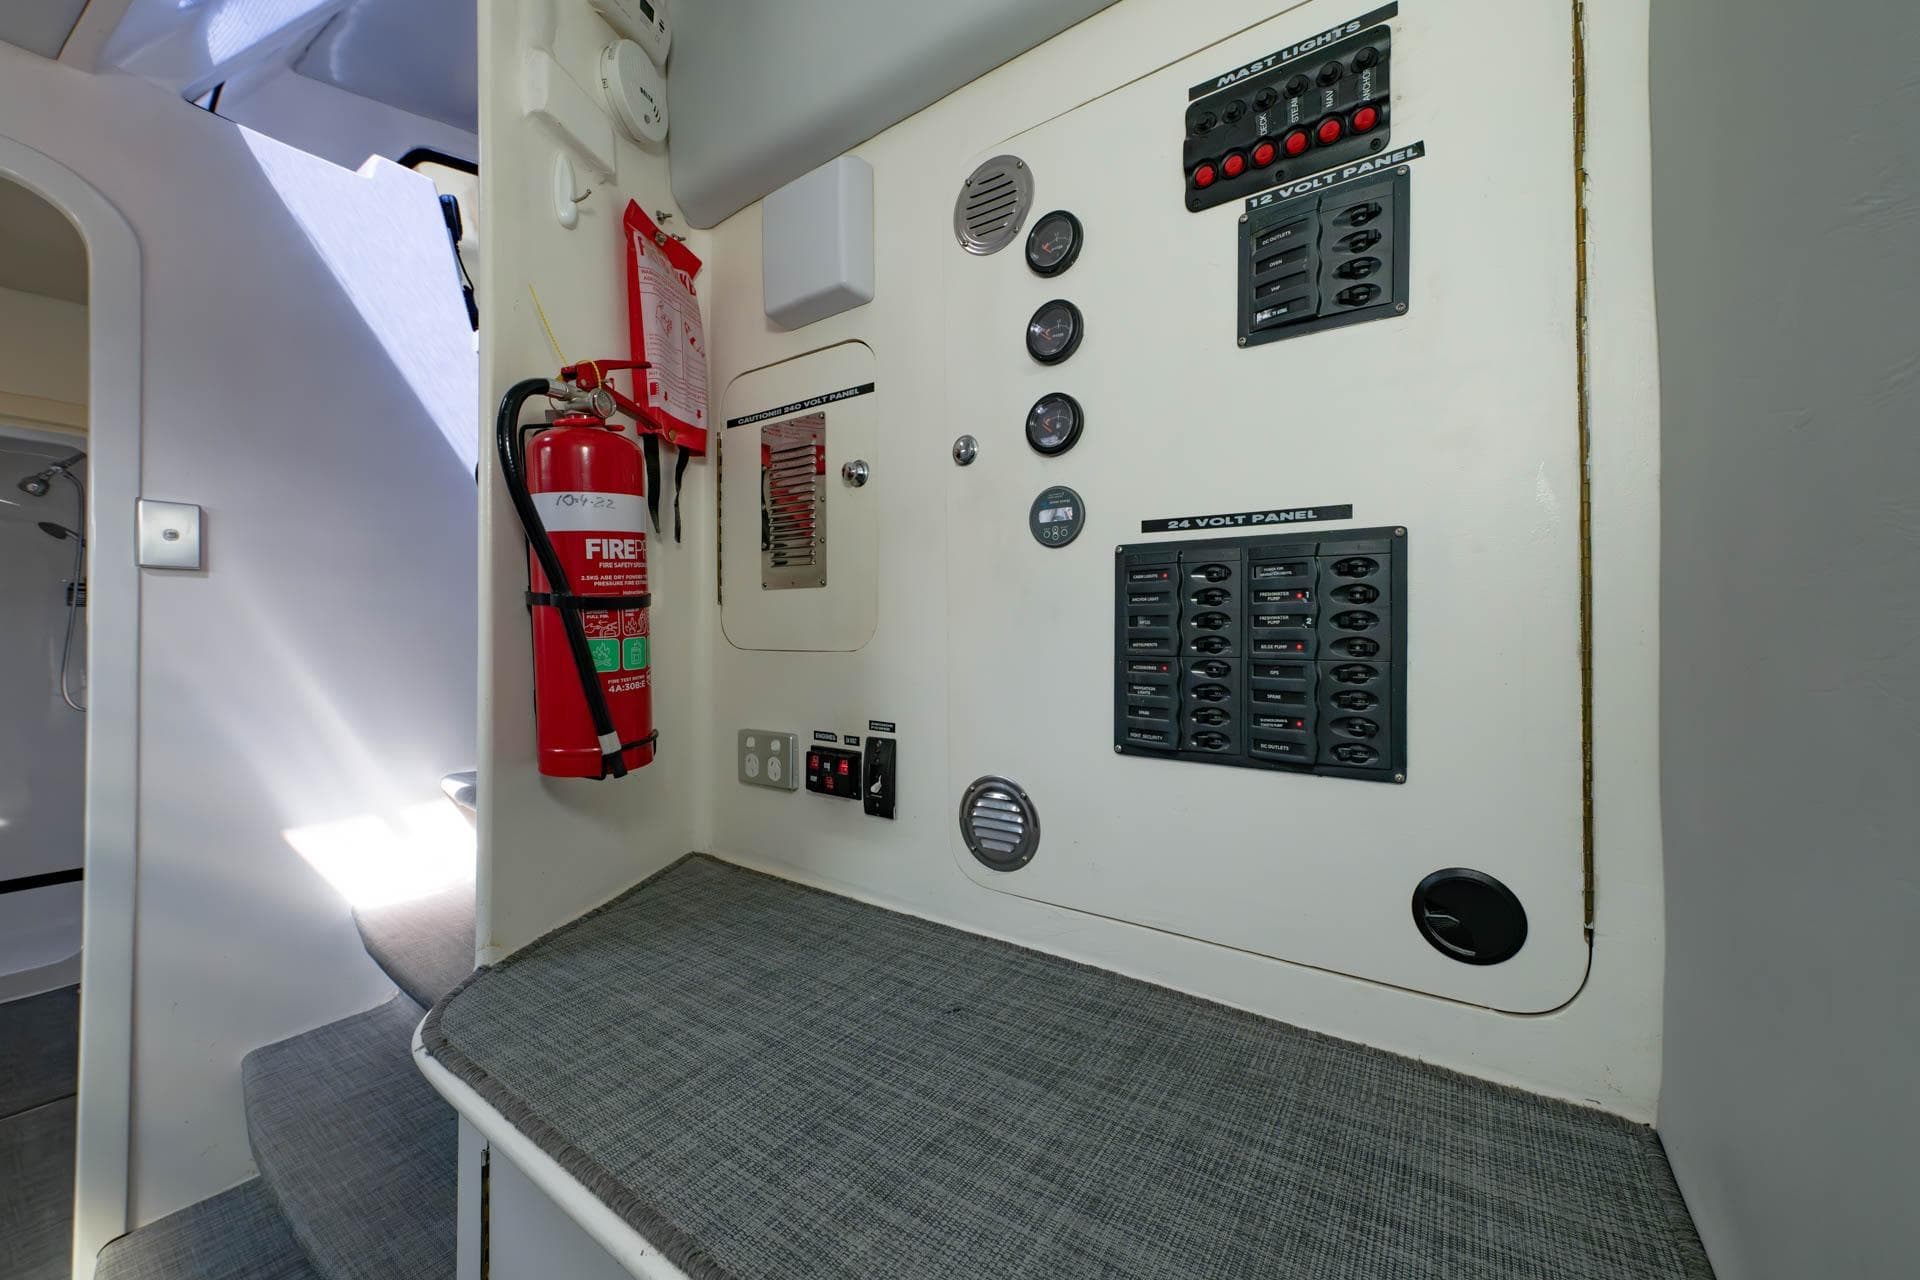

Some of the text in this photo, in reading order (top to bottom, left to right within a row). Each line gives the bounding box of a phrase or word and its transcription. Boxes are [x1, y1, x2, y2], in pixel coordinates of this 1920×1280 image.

[1217, 21, 1361, 87] MAST LIGHTS
[1326, 90, 1334, 108] NAV
[1260, 113, 1268, 136] DECK
[1251, 149, 1418, 208] 12 VOLT PANEL
[784, 404, 801, 415] 240
[804, 397, 828, 409] VOLT
[830, 388, 860, 401] PANEL
[1168, 510, 1318, 529] 24 VOLT PANEL
